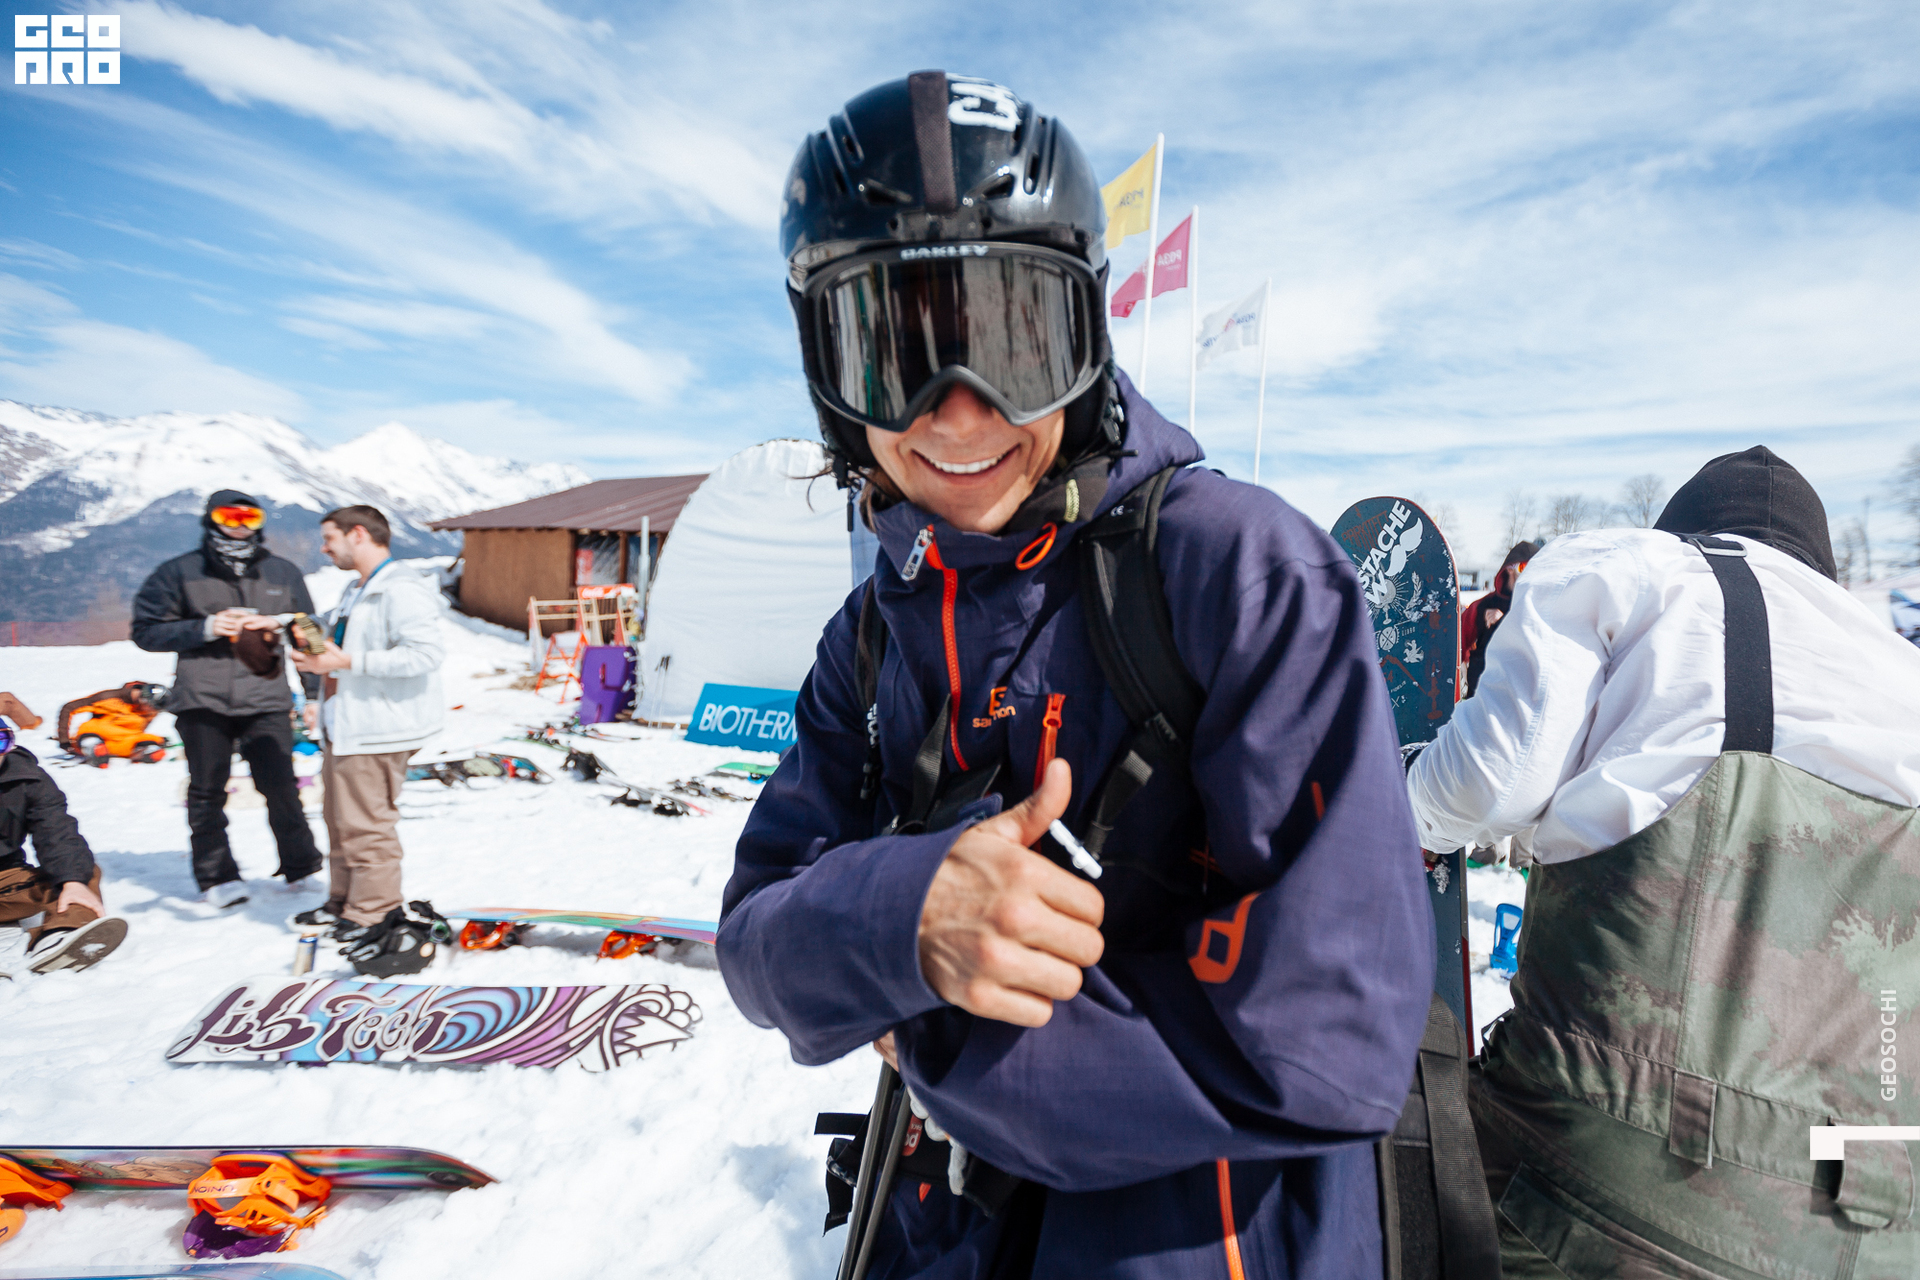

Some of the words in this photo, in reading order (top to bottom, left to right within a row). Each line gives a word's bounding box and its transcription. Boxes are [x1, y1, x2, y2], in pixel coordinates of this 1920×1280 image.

[901, 245, 989, 260] OAKLEY
[1357, 500, 1412, 590] STACHE
[165, 981, 314, 1060] Lib
[316, 985, 460, 1061] Tech
[193, 1184, 235, 1194] UNION
